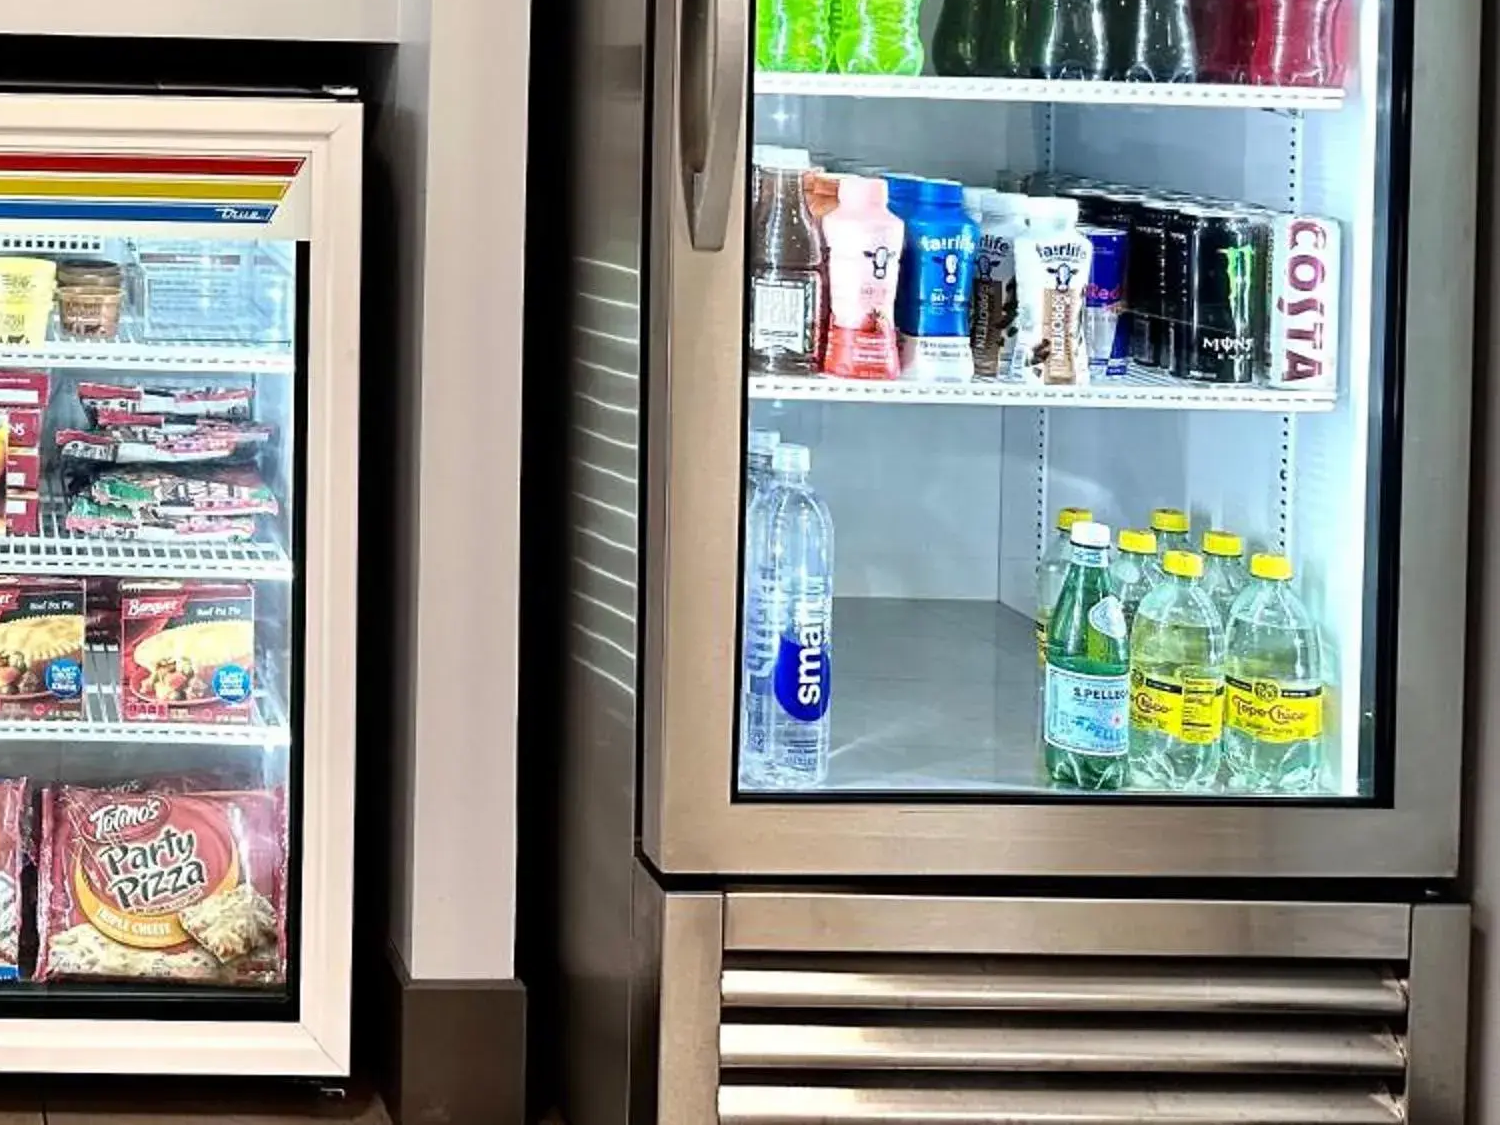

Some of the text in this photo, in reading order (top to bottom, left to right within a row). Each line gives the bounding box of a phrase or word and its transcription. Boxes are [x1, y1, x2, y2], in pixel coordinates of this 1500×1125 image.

[1278, 217, 1325, 382] COSTA
[128, 599, 180, 616] Banquet
[90, 800, 162, 841] Totino's
[100, 828, 196, 876] Party
[111, 859, 206, 910] Pizza
